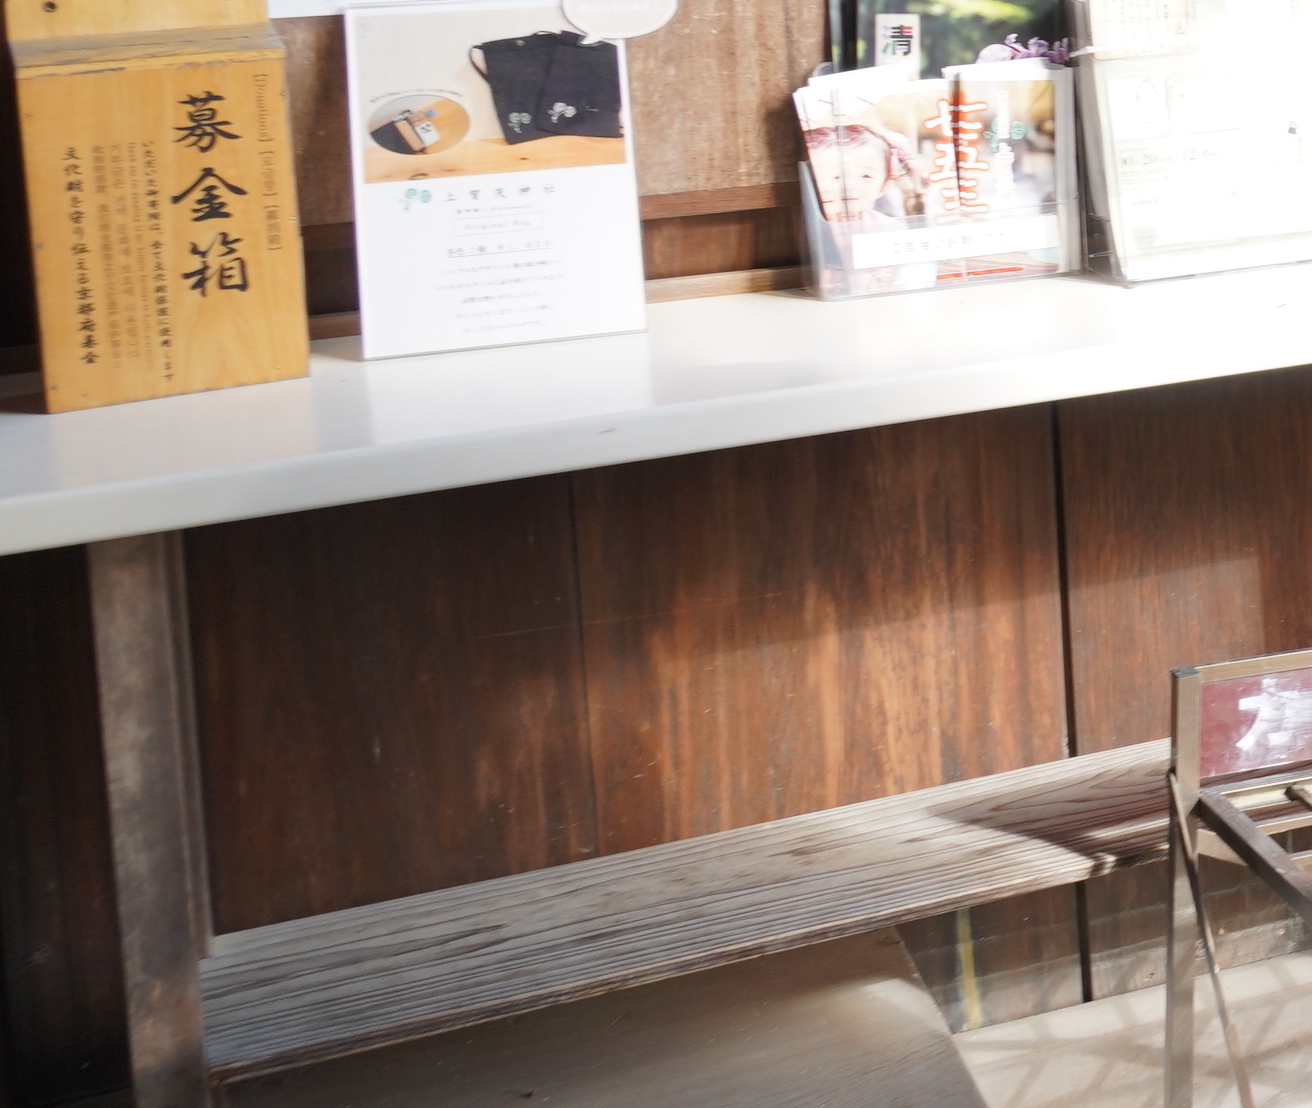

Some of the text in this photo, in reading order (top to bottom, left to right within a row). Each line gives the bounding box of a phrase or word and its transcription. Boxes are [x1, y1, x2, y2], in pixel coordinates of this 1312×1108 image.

[881, 24, 914, 57] 清
[172, 90, 250, 298] 募金箱
